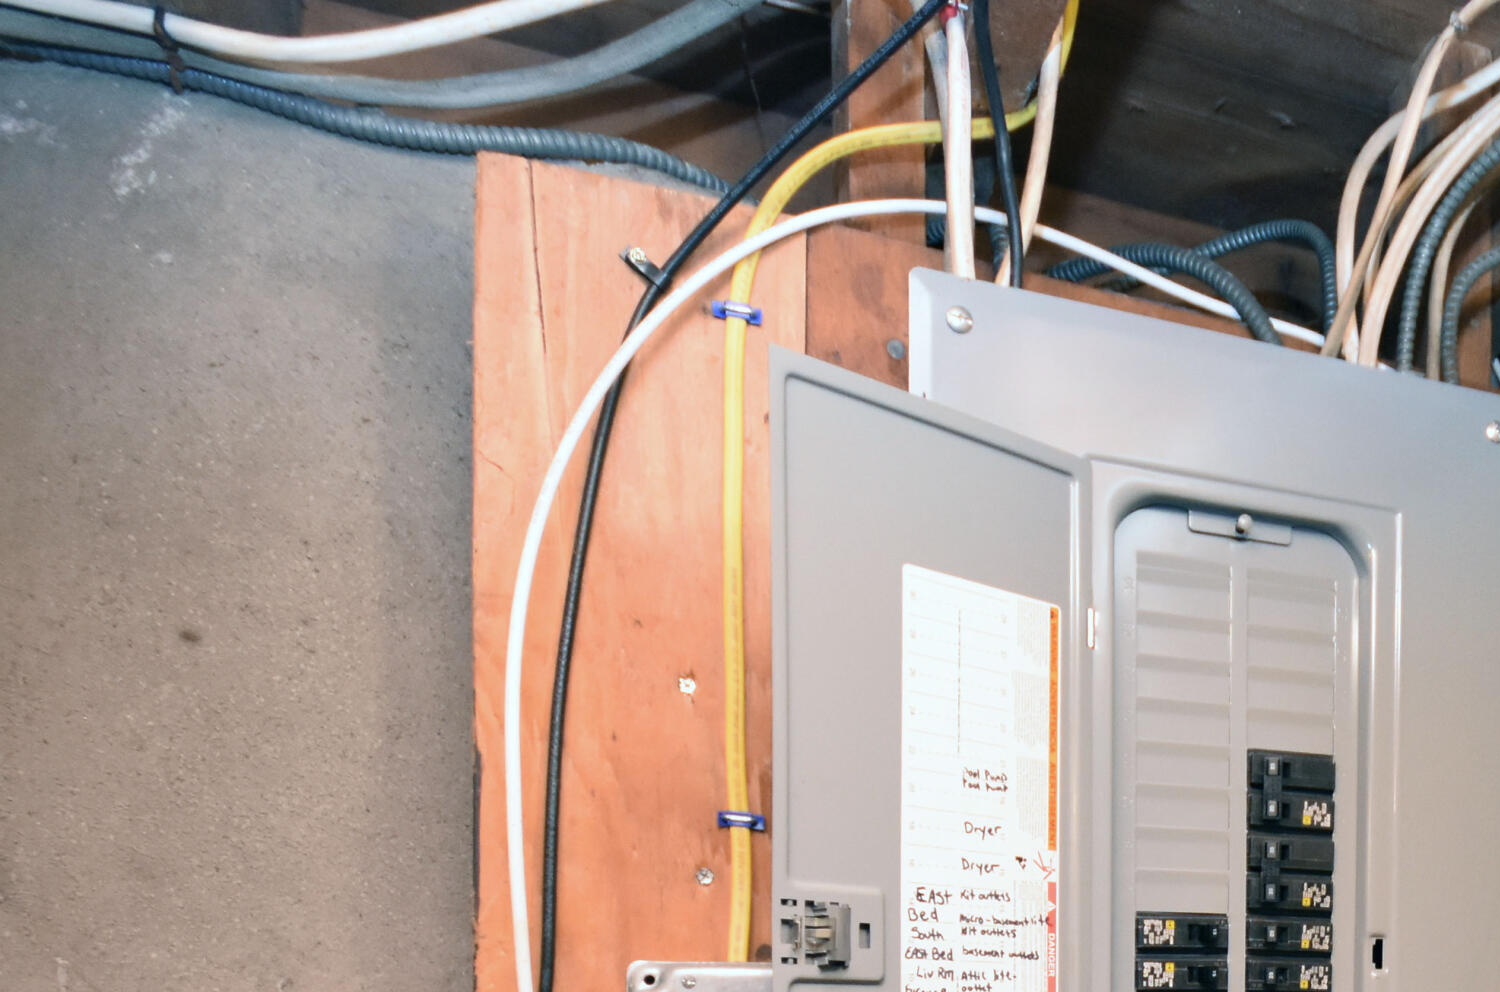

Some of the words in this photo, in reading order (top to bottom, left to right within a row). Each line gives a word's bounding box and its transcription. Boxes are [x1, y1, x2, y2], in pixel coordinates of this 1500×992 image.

[964, 820, 1003, 841] Dryer
[961, 856, 1001, 877] Dryer
[907, 907, 939, 922] Bed
[931, 946, 954, 962] Bed
[1048, 932, 1056, 977] DANGER
